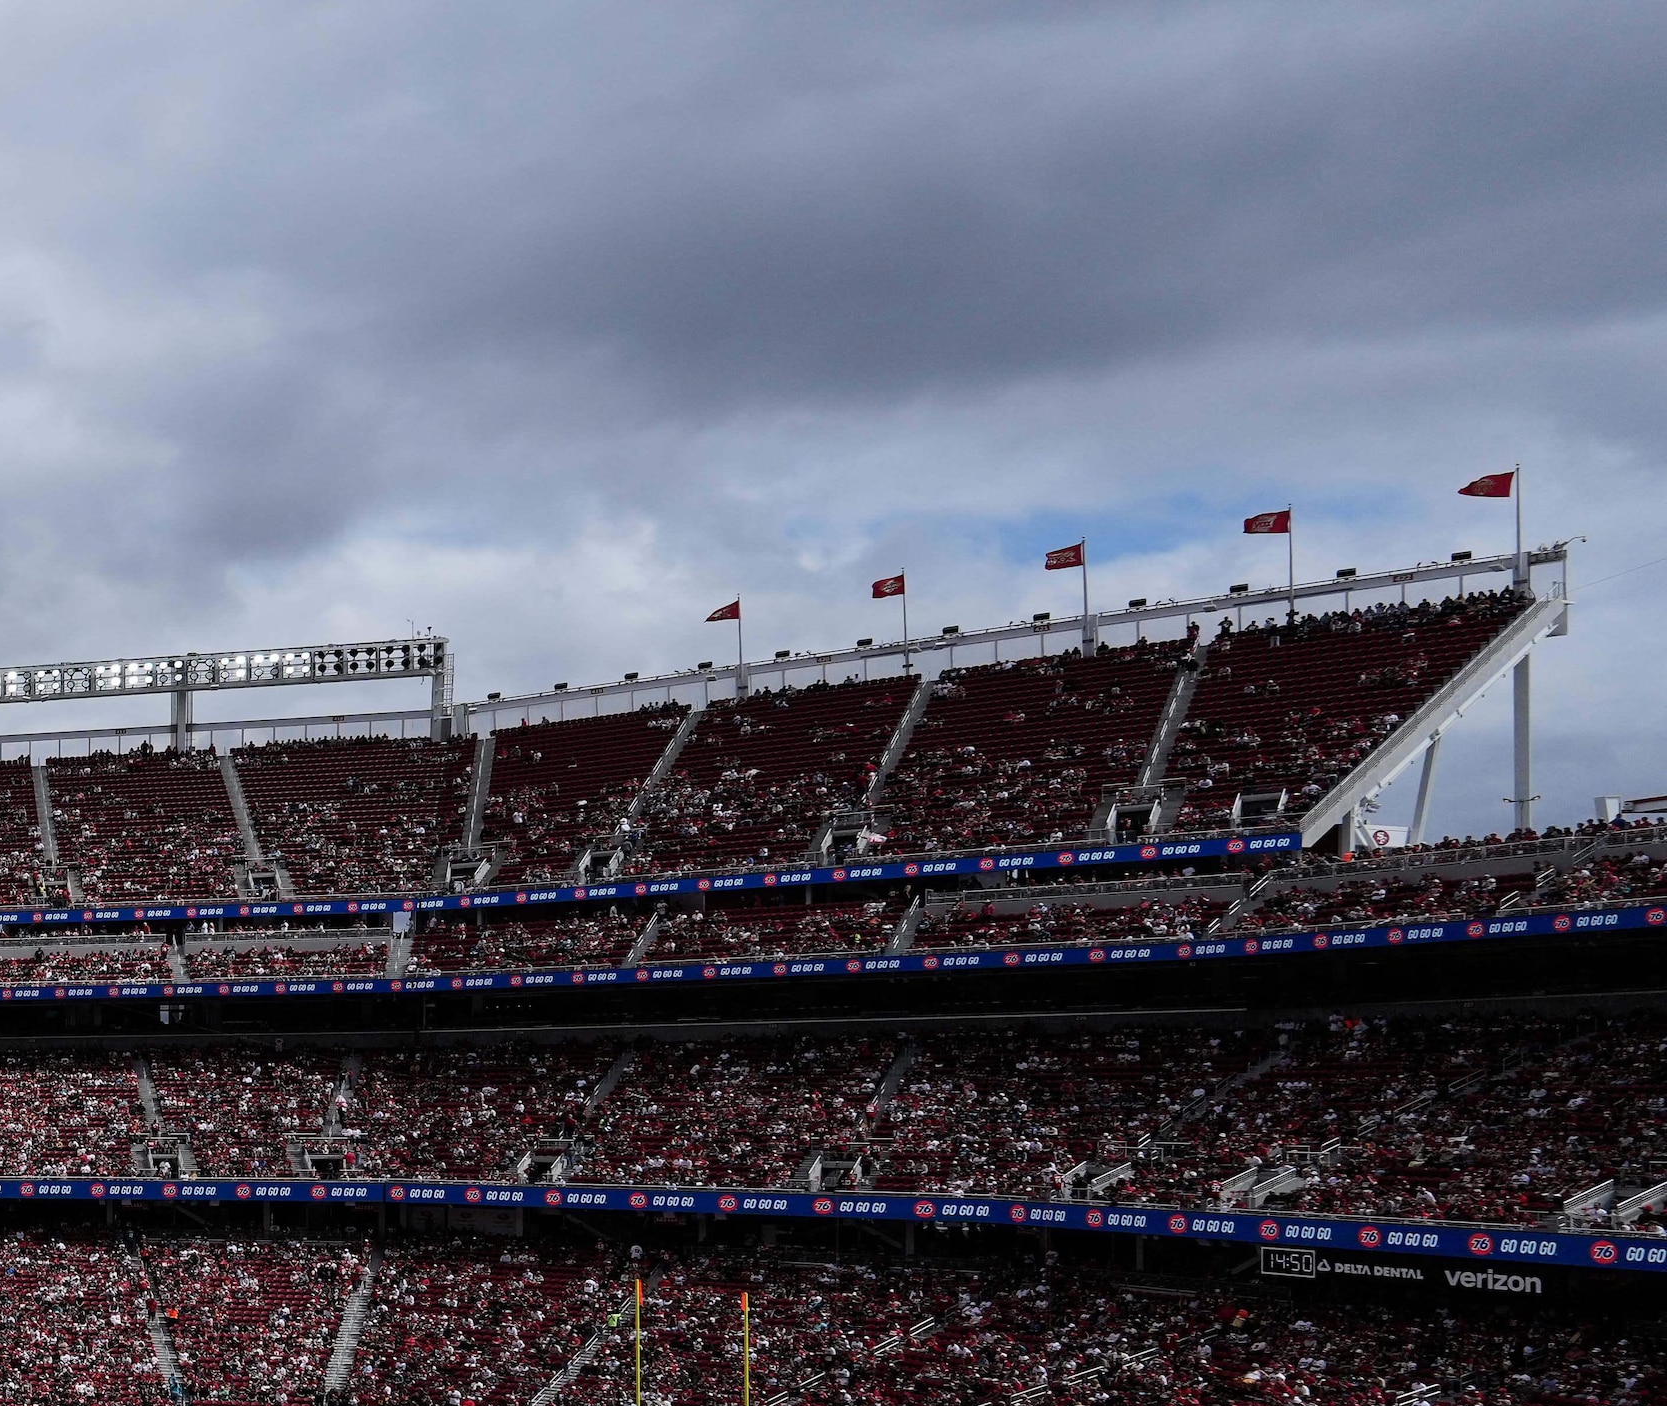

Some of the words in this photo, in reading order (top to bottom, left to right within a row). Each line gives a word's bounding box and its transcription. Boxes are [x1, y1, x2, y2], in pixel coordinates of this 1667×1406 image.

[631, 1195, 645, 1205] 76
[653, 1196, 665, 1206] GO
[667, 1197, 679, 1206] GO
[681, 1197, 694, 1207] GO
[1470, 1237, 1490, 1251] 76
[1500, 1239, 1517, 1253] GO
[1520, 1240, 1536, 1254] GO
[1539, 1241, 1557, 1256] GO
[1270, 1253, 1313, 1273] 14:50
[1334, 1262, 1372, 1275] DELTA
[1373, 1265, 1424, 1280] DENTAL
[1444, 1269, 1542, 1294] verizon
